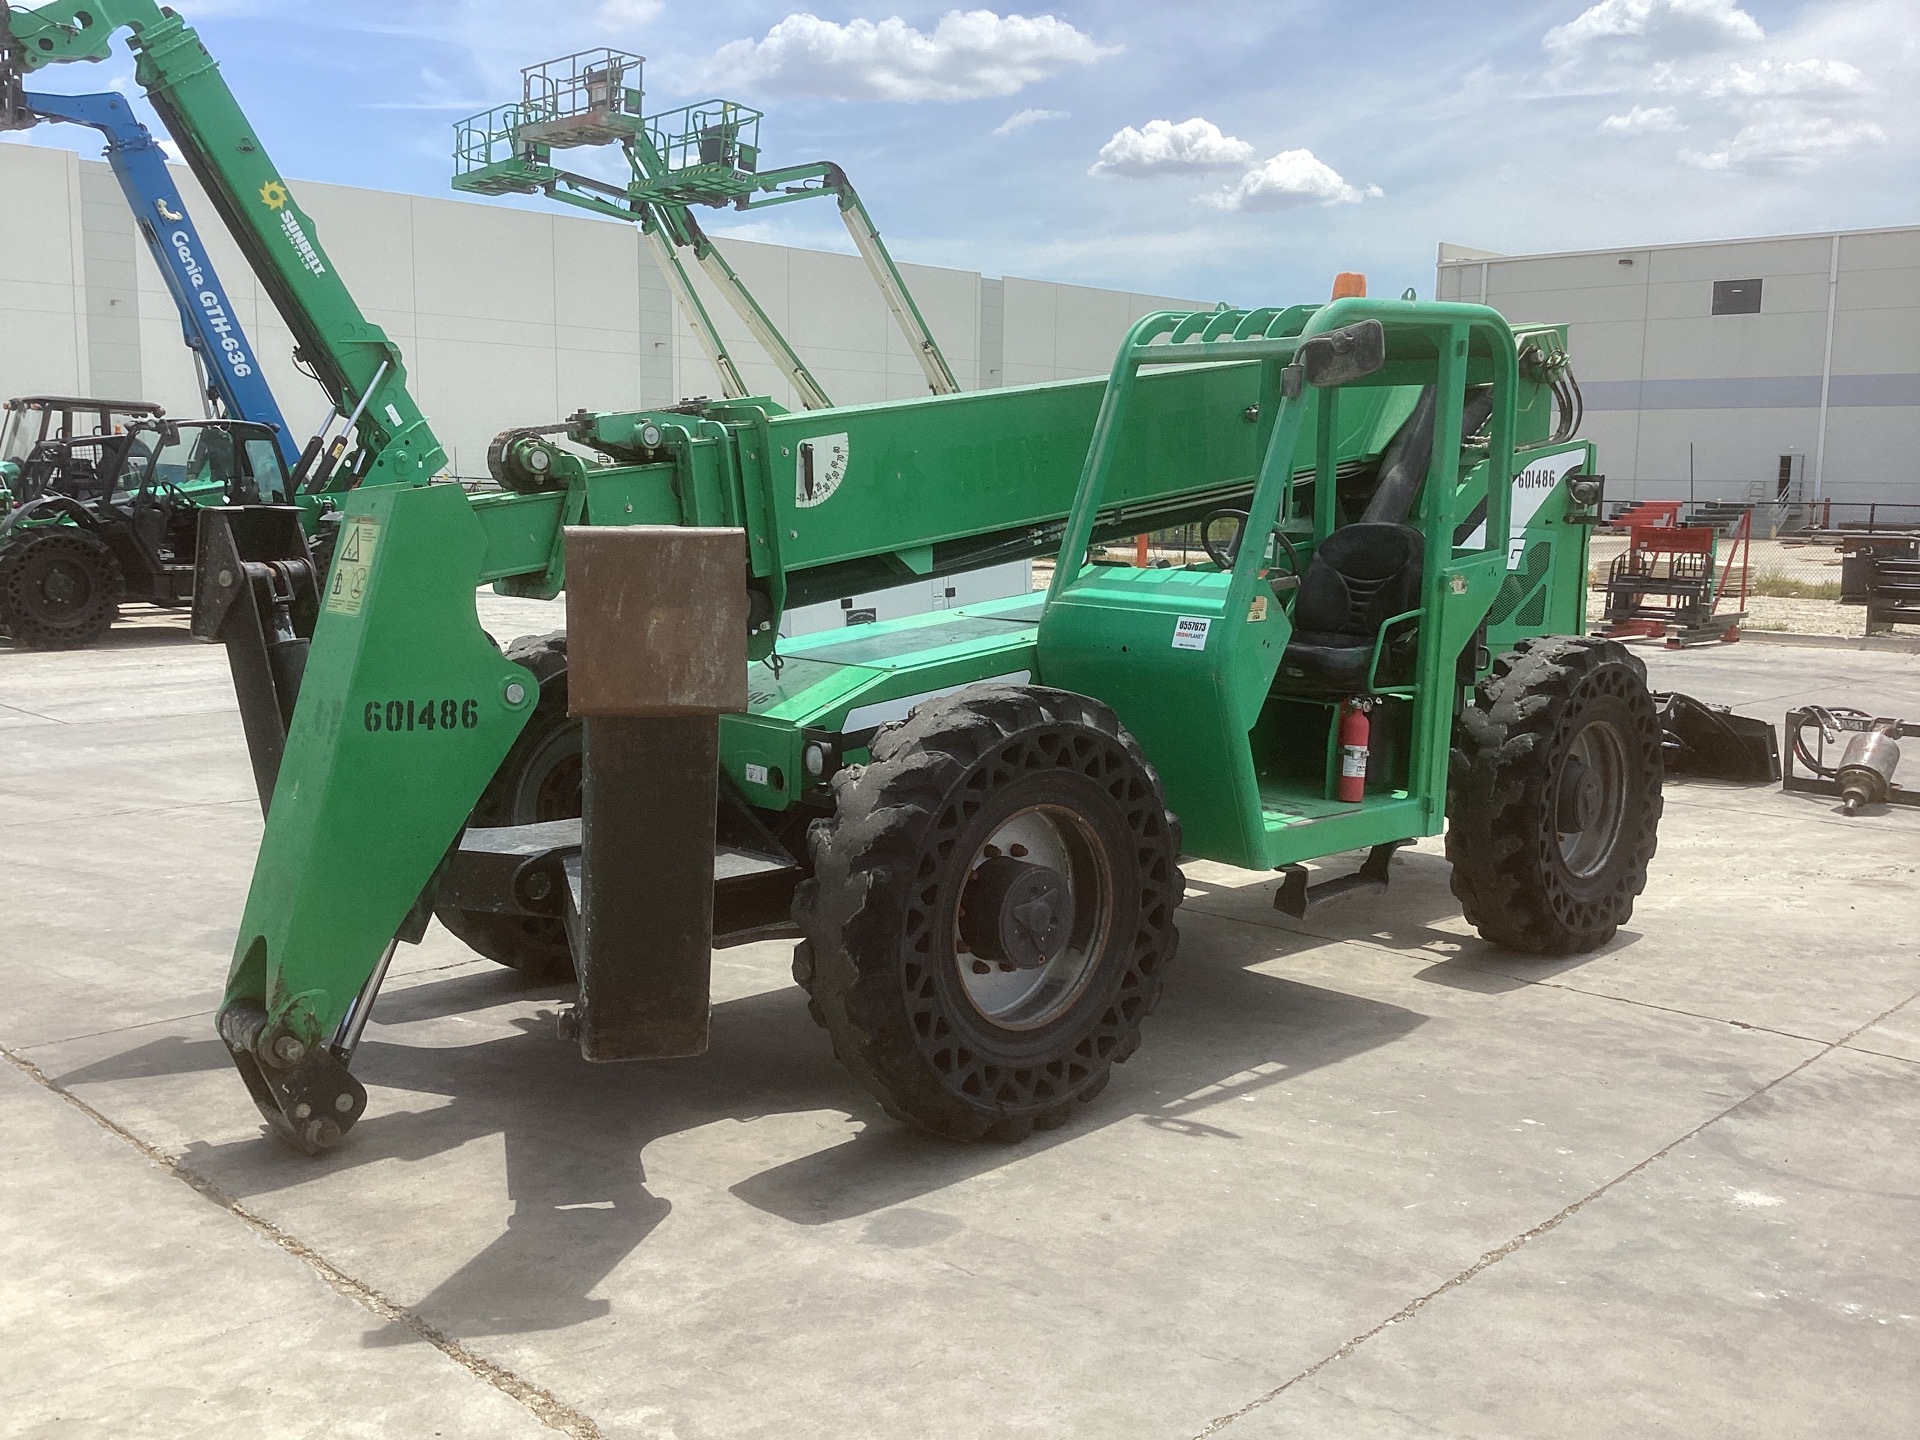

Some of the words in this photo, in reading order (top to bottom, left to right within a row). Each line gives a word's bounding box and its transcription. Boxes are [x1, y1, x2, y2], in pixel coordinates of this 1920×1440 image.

[523, 163, 541, 173] JLG
[728, 170, 748, 183] JLG
[280, 209, 326, 275] SUNBELT
[281, 223, 311, 270] RENTALS
[171, 230, 205, 289] Genie
[199, 290, 252, 378] GTH-636
[1518, 469, 1556, 490] 601486
[1179, 620, 1207, 632] U557673
[364, 698, 479, 732] 601486
